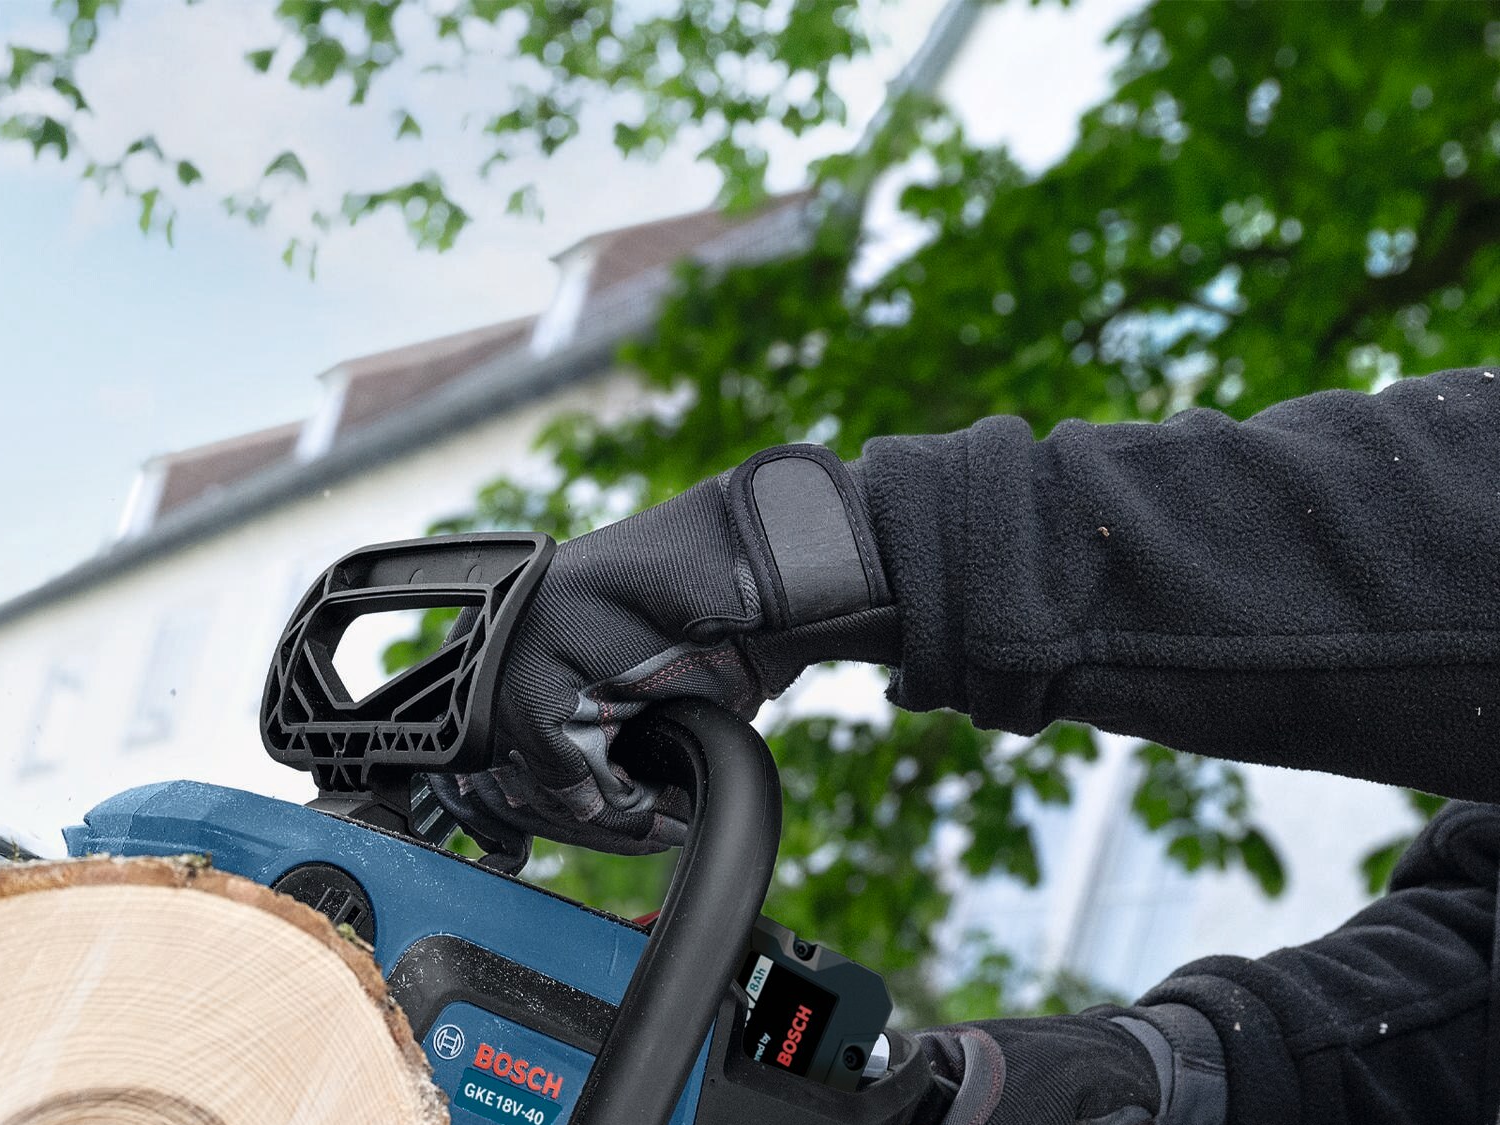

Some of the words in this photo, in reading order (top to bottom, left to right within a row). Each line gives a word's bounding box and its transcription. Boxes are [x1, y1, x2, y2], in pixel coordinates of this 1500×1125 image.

[749, 968, 767, 993] 8Ah
[759, 1032, 771, 1044] by
[776, 1004, 813, 1067] BOSCH
[473, 1042, 564, 1100] BOSCH
